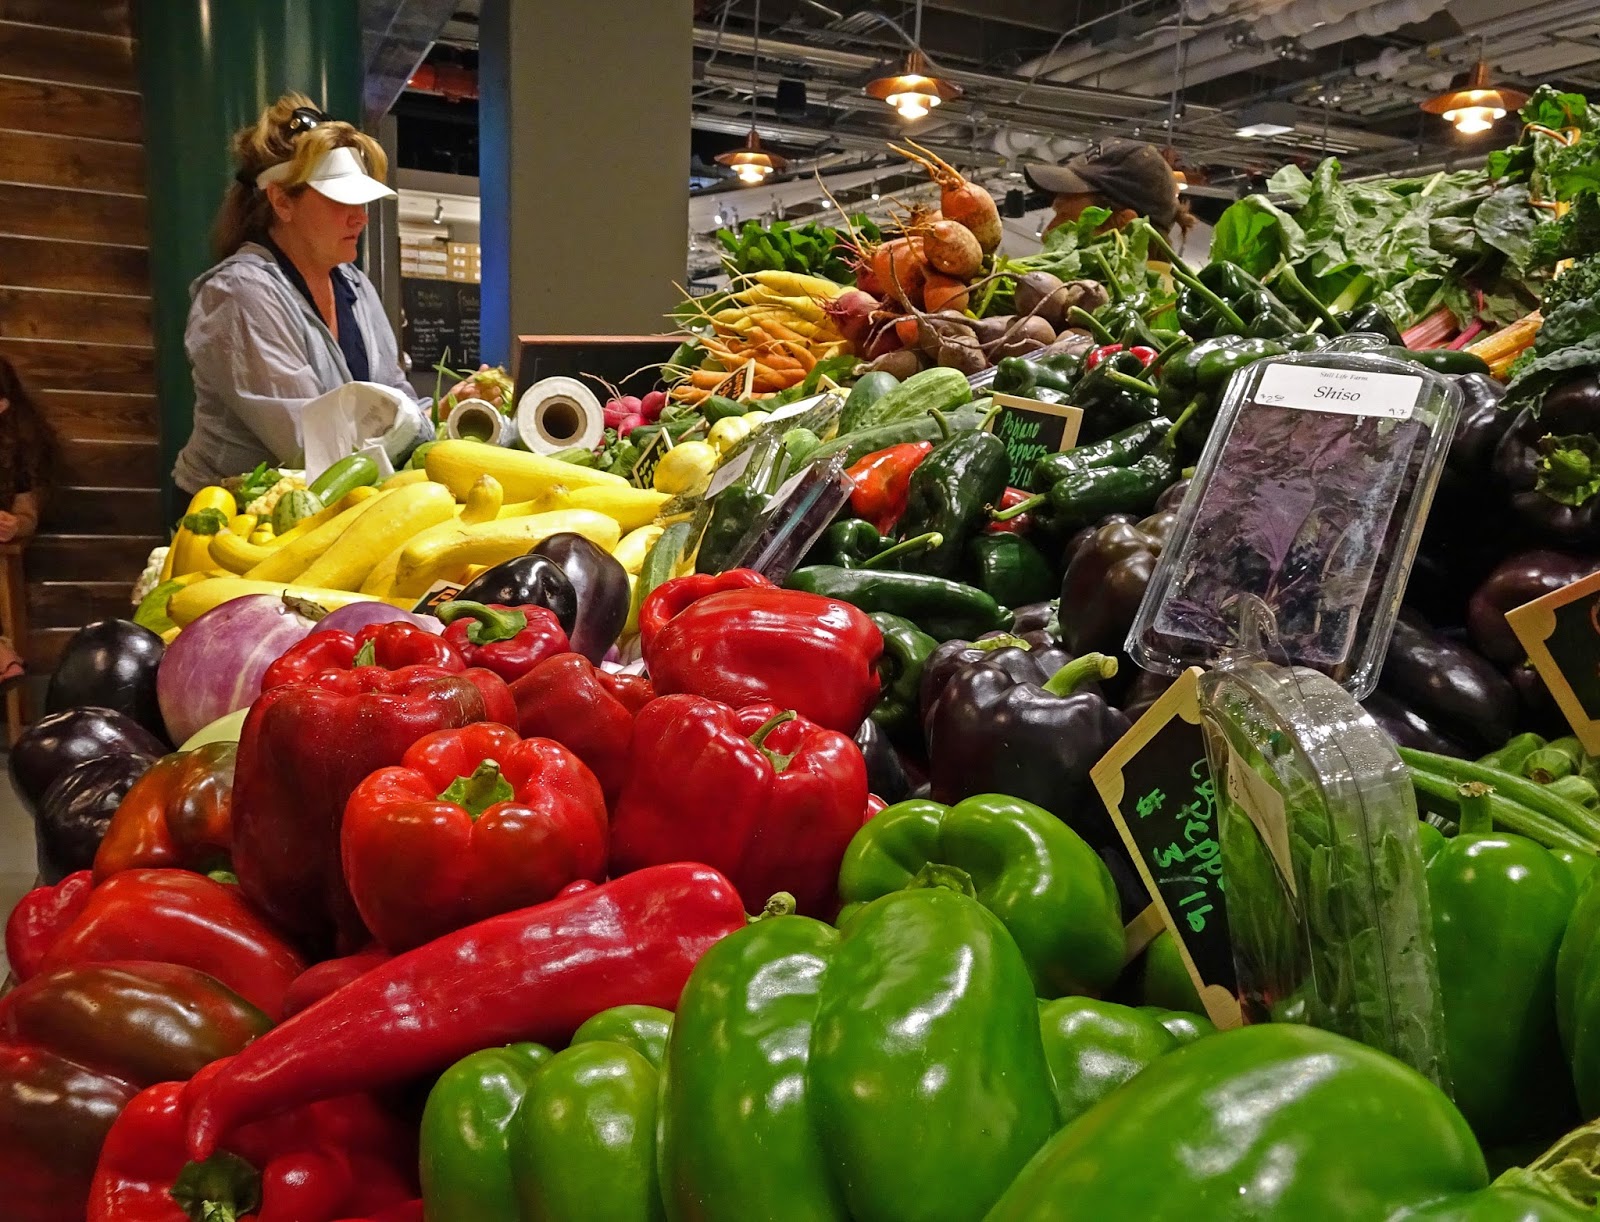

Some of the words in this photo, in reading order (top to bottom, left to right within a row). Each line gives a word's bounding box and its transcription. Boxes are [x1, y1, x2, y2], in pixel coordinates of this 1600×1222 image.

[1320, 371, 1335, 379] Still
[1313, 385, 1361, 402] Shiso
[998, 410, 1041, 440] Poblano
[1006, 436, 1048, 468] Peppers
